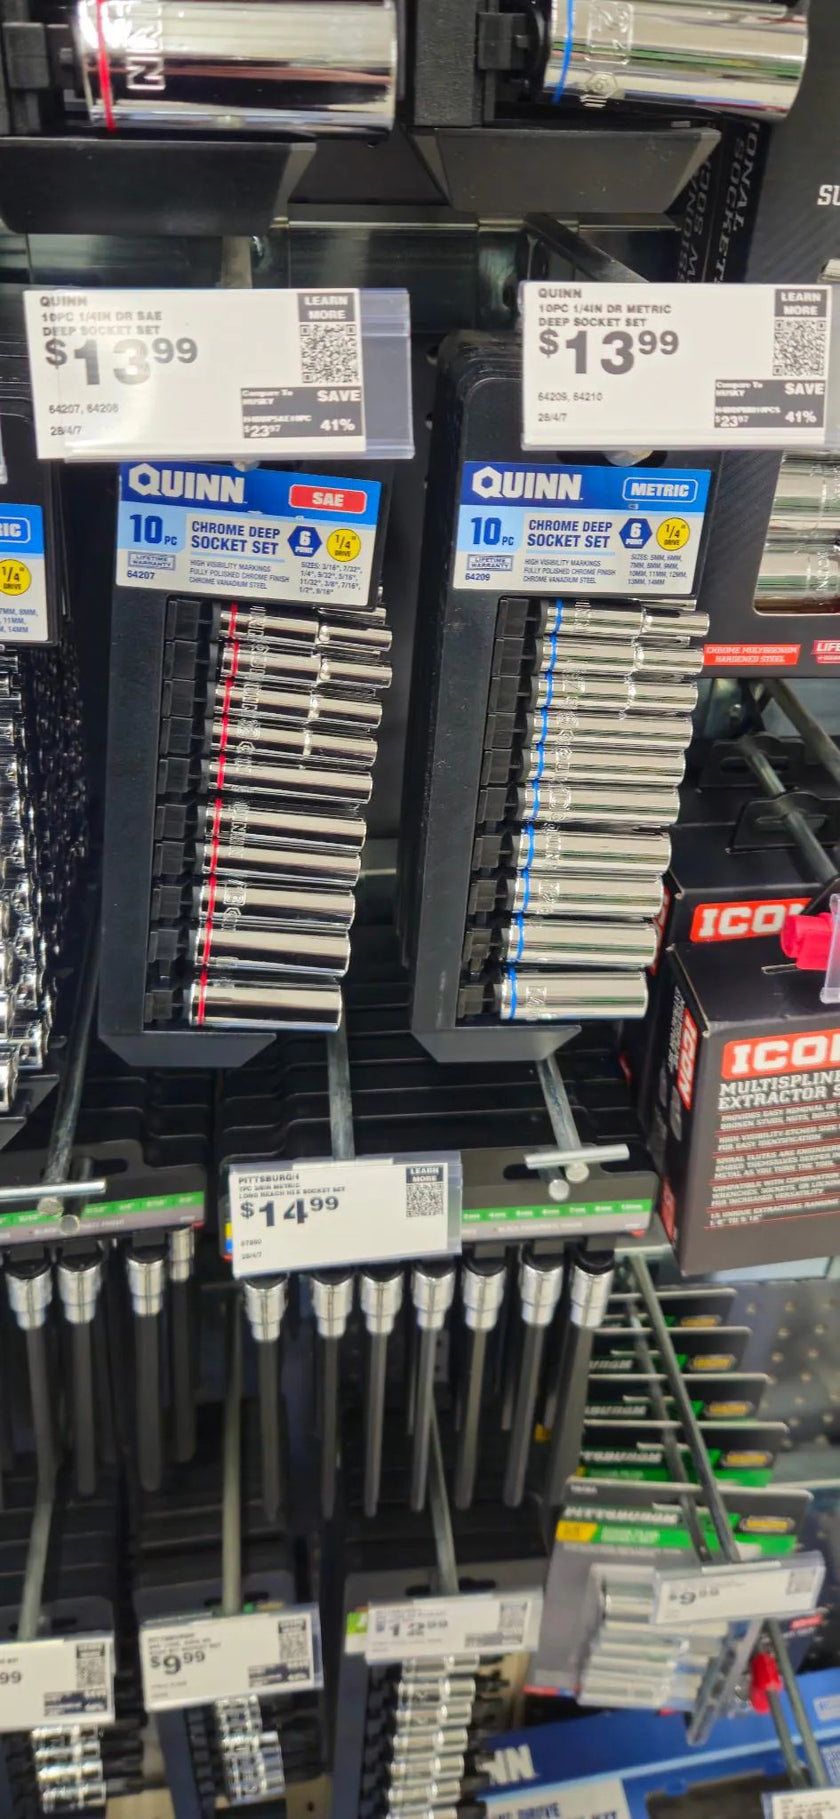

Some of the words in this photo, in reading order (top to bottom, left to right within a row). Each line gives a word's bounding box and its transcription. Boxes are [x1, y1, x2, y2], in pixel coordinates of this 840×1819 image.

[538, 288, 582, 299] QUINN
[781, 292, 821, 302] LEARN
[40, 296, 87, 307] QUINN
[304, 296, 349, 306] LEARN
[308, 309, 346, 320] MORE
[539, 304, 569, 313] 10PC
[574, 304, 603, 313] 1/4IN
[607, 304, 622, 313] DR
[627, 305, 672, 314] METRIC
[783, 305, 818, 316] MORE
[42, 312, 74, 322] 10PC
[79, 311, 111, 321] 1/4IN
[115, 311, 133, 321] DR
[137, 311, 162, 321] SAE
[538, 318, 570, 327] DEEP
[573, 318, 621, 327] SOCKET
[625, 318, 647, 327] SET
[43, 327, 76, 336] DEEP
[80, 326, 132, 336] SOCKET
[136, 325, 161, 335] SET
[784, 382, 825, 395] SAVE
[316, 389, 362, 402] SAVE
[785, 410, 817, 423] 41%
[320, 418, 356, 432] 41%
[128, 463, 246, 504] QUINN
[471, 465, 583, 501] QUINN
[630, 482, 690, 498] METRIC
[312, 491, 345, 508] SAE
[129, 514, 163, 545] 10
[164, 536, 178, 546] PC
[191, 520, 245, 537] CHROME
[248, 525, 281, 540] DEEP
[471, 517, 502, 546] 10
[502, 536, 515, 546] PC
[528, 519, 581, 533] CHROME
[583, 520, 613, 533] DEEP
[630, 522, 642, 538] 6
[299, 530, 312, 546] 6
[527, 533, 581, 548] SOCKET
[585, 535, 610, 549] SET
[190, 535, 247, 552] SOCKET
[251, 541, 279, 555] SET
[135, 554, 168, 562] LIFETIME
[334, 549, 352, 557] DRIVE
[189, 559, 206, 567] HIGH
[206, 560, 237, 570] VISIBILITY
[238, 563, 271, 573] MARKINGS
[540, 559, 569, 567] VISIBILITY
[126, 569, 156, 580] 64207
[189, 567, 208, 576] FULLY
[209, 569, 240, 579] POLISHED
[241, 572, 268, 581] CHROME
[269, 575, 290, 583] FINISH
[465, 572, 491, 581] 64209
[523, 575, 547, 583] CHROME
[189, 576, 215, 586] CHROME
[216, 578, 248, 588] VANADIUM
[249, 581, 268, 590] STEEL
[698, 903, 804, 937] ICO
[718, 1086, 827, 1111] EXTRACTOR
[409, 1166, 439, 1176] LEARN
[238, 1173, 300, 1184] PITTSBURGH
[411, 1175, 437, 1183] MORE
[303, 1187, 331, 1195] SOCKET
[564, 1505, 678, 1524] PITTSBURGH
